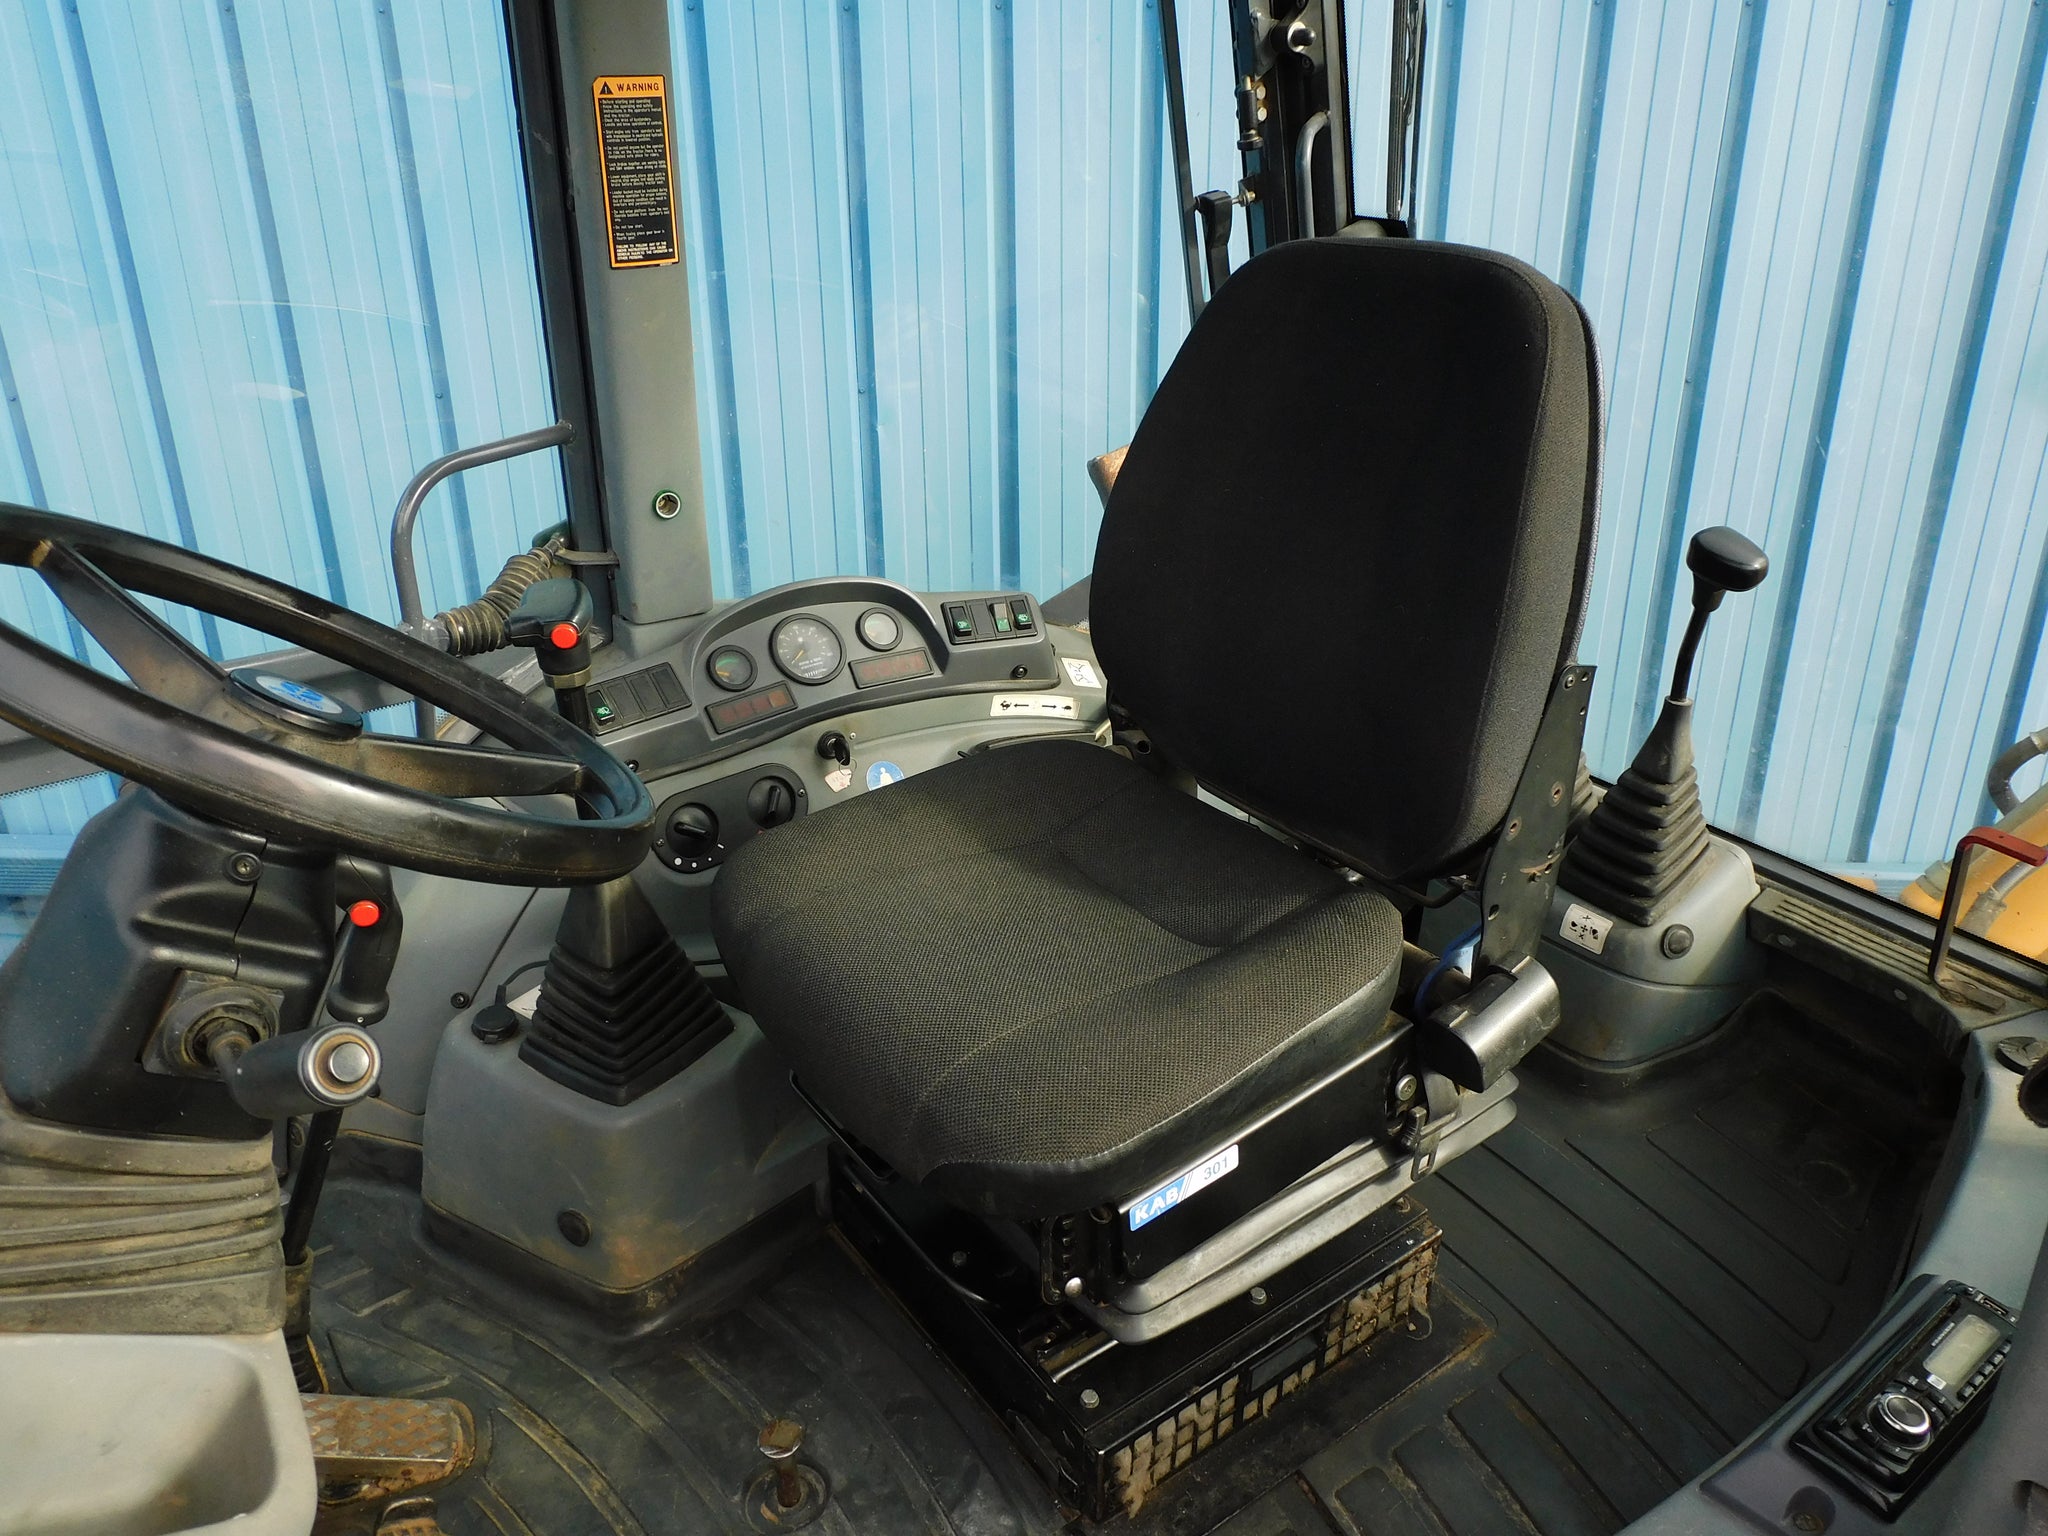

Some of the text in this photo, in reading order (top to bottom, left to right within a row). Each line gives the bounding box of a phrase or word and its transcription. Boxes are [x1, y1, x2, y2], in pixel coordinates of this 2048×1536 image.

[617, 83, 660, 92] WARNING
[1135, 1157, 1228, 1224] KAB 301
